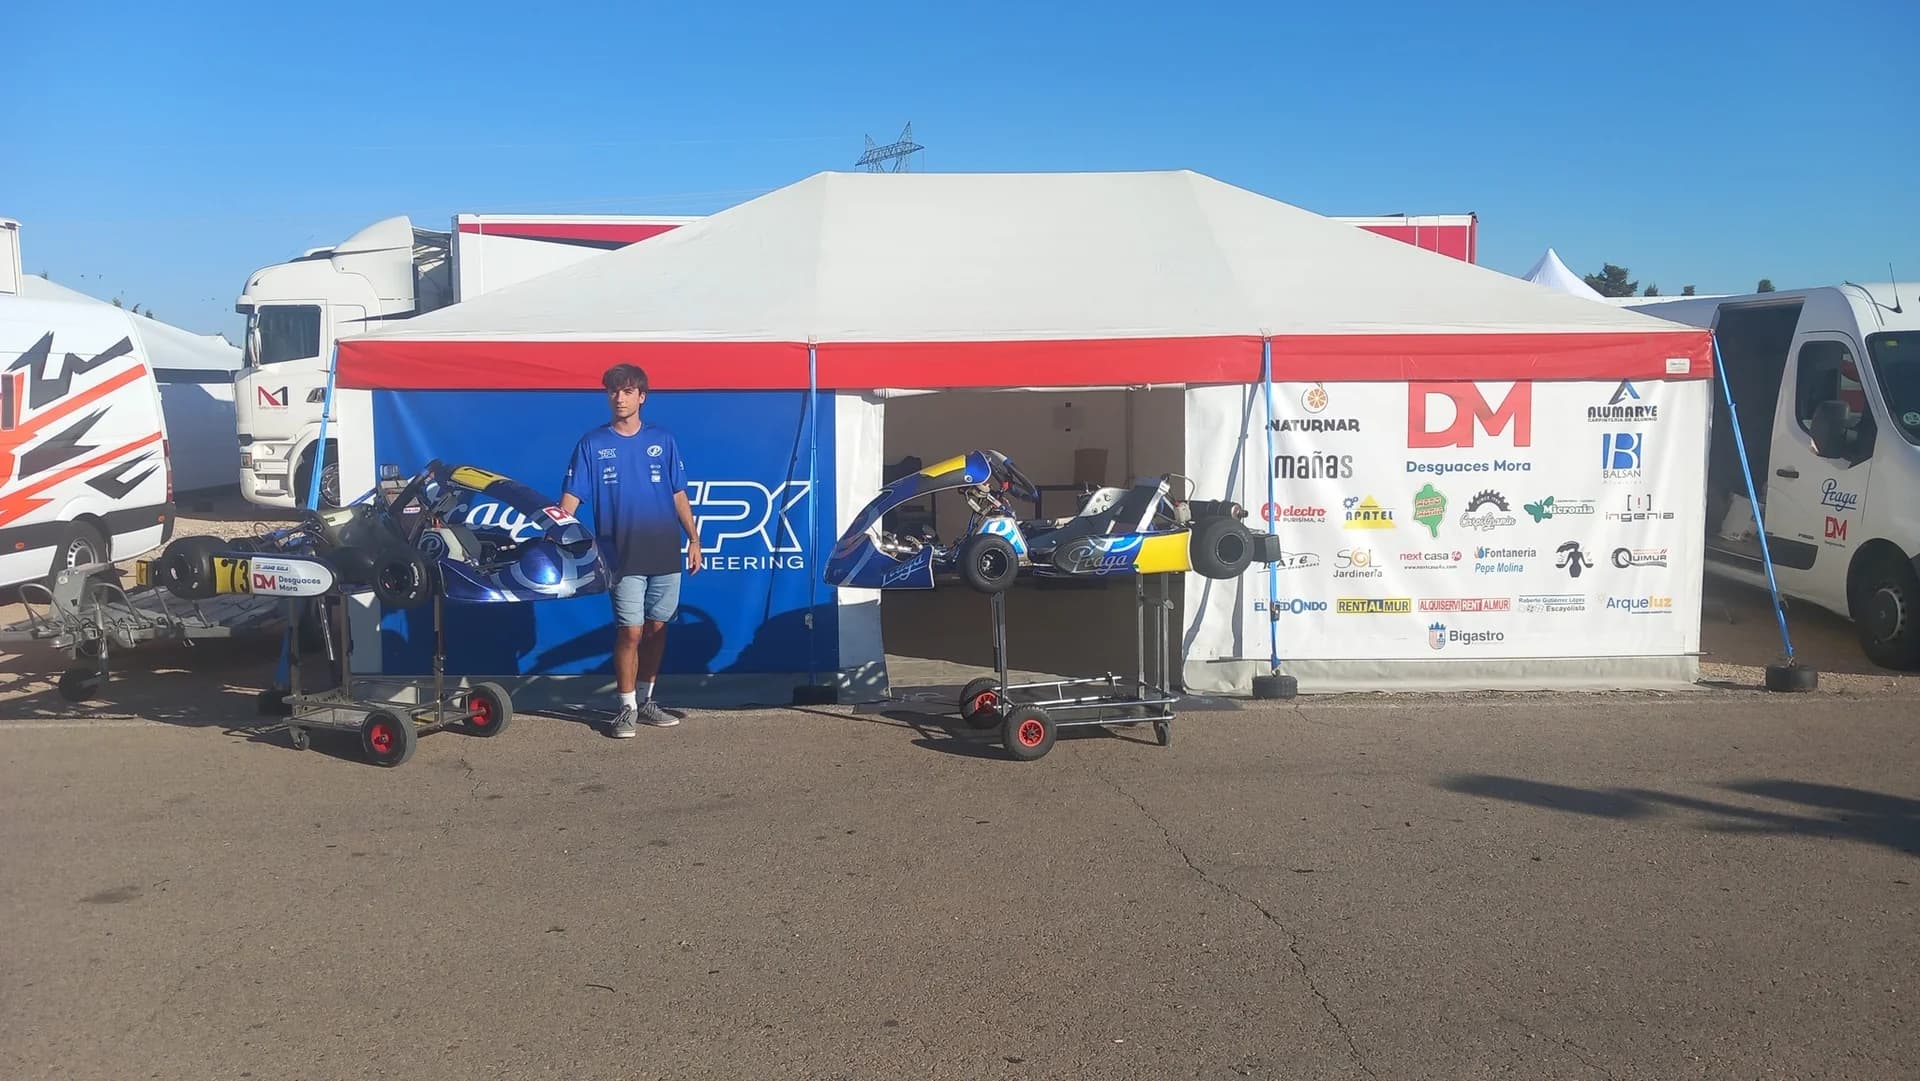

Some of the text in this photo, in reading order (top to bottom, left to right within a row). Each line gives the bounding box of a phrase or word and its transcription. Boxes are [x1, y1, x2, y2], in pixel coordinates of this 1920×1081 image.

[1407, 382, 1532, 448] DM
[1587, 405, 1657, 418] ALUMARVE
[1265, 419, 1360, 432] NATURNAR
[1274, 451, 1353, 479] mañas
[1406, 460, 1531, 475] Desguaces Mora
[1603, 470, 1641, 478] BALSAN
[1820, 478, 1858, 512] Praga
[1283, 506, 1327, 517] electro
[1345, 510, 1393, 521] APATEL
[1543, 504, 1595, 515] Micronia
[1606, 512, 1675, 522] ingenia
[1825, 516, 1847, 541] DM
[1400, 552, 1449, 561] next casa
[1485, 547, 1537, 558] Fontaneria
[1475, 562, 1523, 574] Pepe Molina
[221, 558, 249, 593] 73
[253, 573, 277, 590] DM
[278, 575, 321, 586] Desguaces
[279, 584, 298, 592] Mora
[1254, 599, 1327, 614] EL EDONDO
[1461, 600, 1482, 611] RENT
[1483, 599, 1509, 610] ALMUR
[1606, 595, 1672, 612] Arqueluz
[1450, 630, 1504, 645] Bigastro
